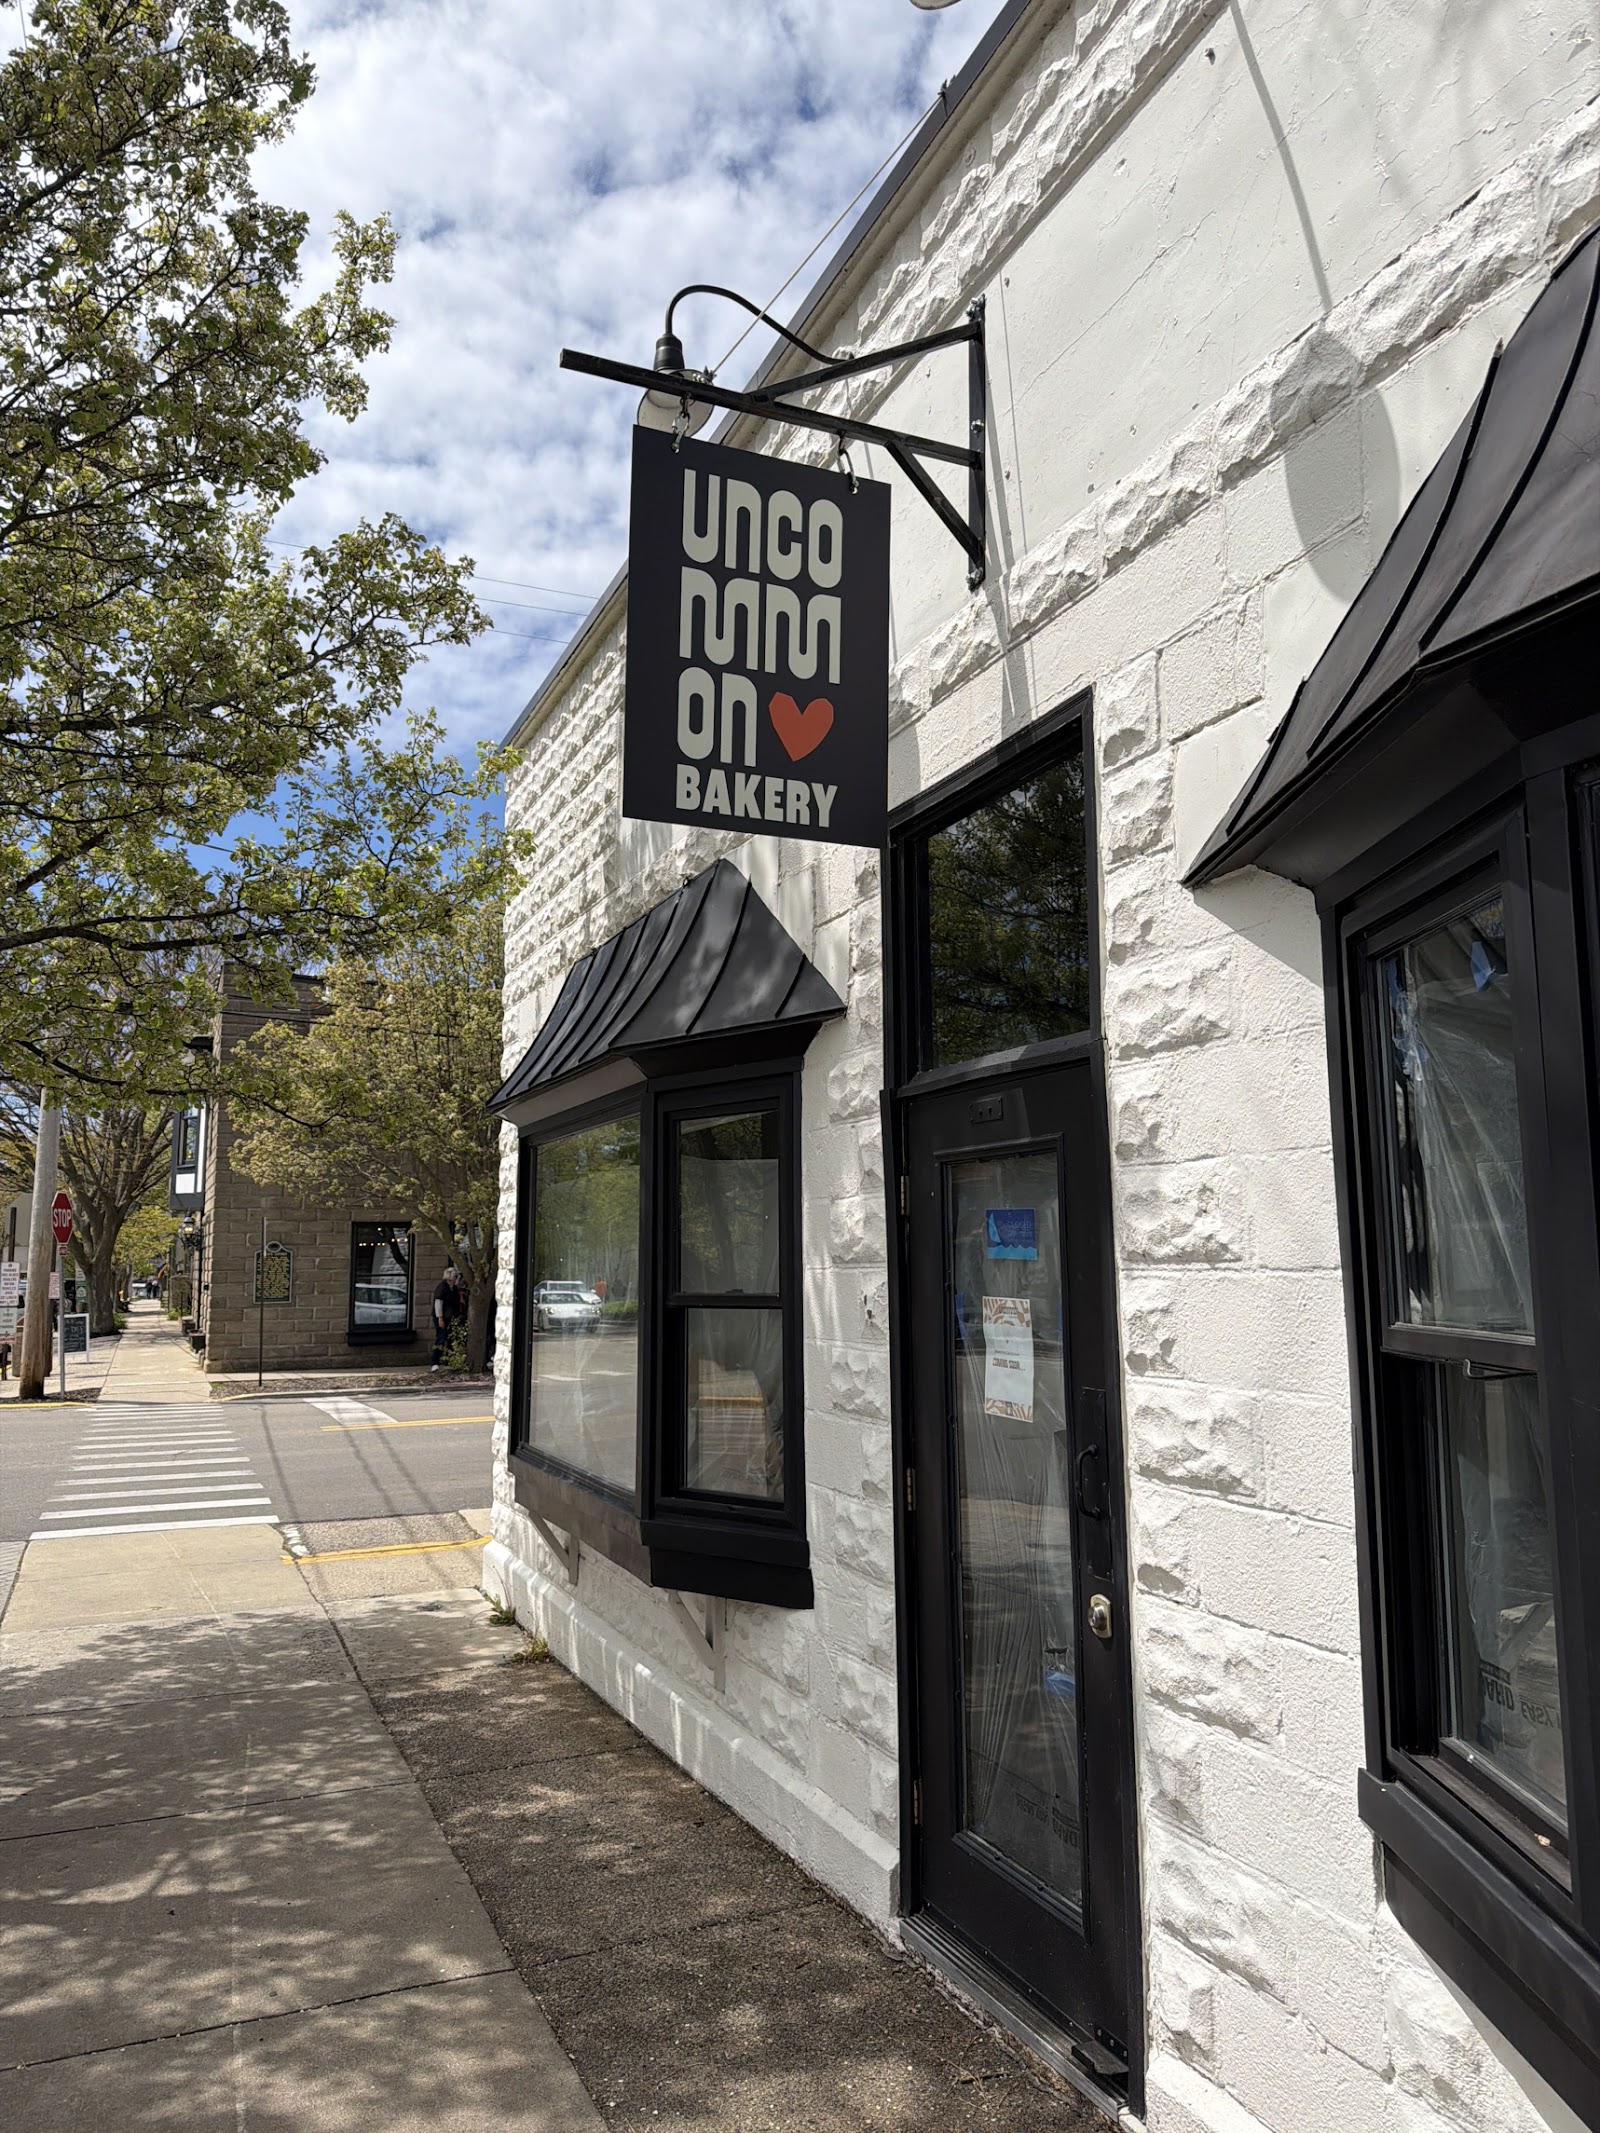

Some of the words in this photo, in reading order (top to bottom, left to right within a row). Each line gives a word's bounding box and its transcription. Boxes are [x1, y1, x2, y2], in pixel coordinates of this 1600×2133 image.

[677, 666, 758, 767] ON
[676, 763, 838, 828] BAKERY
[53, 1208, 72, 1228] STOP
